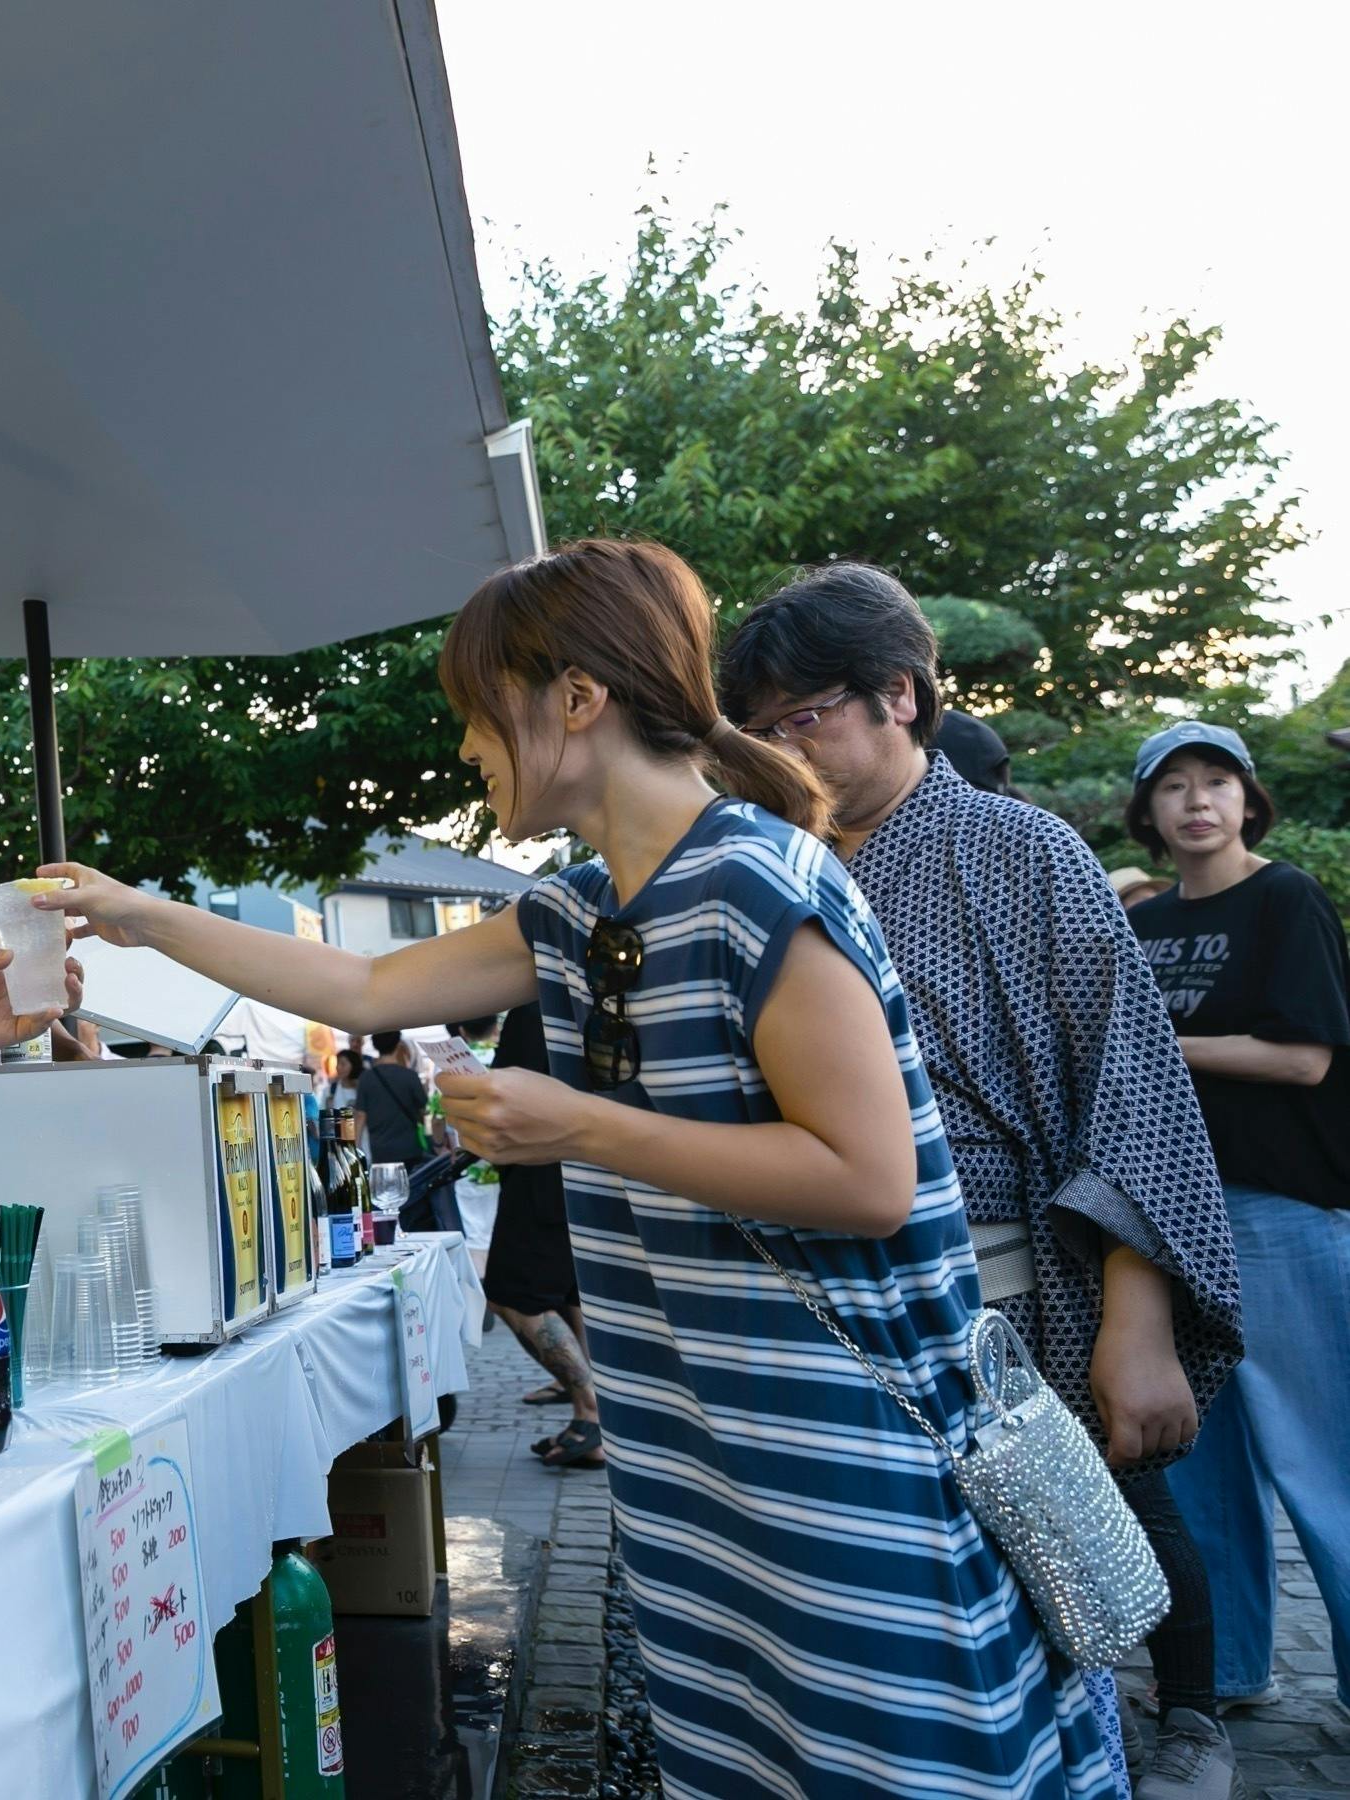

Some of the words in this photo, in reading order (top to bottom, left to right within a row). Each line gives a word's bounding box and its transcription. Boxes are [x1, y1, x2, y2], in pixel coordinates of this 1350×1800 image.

[1191, 933, 1230, 961] TO,
[1189, 964, 1223, 973] STEP
[224, 1138, 256, 1174] PREMIUM
[132, 1491, 172, 1536] ソフトドリンク
[111, 1528, 126, 1556] 500
[168, 1525, 186, 1549] 200
[112, 1563, 128, 1592] 500
[114, 1596, 130, 1630] 500
[174, 1620, 195, 1652] 500
[117, 1638, 132, 1671] 500
[122, 1713, 139, 1748] 700
